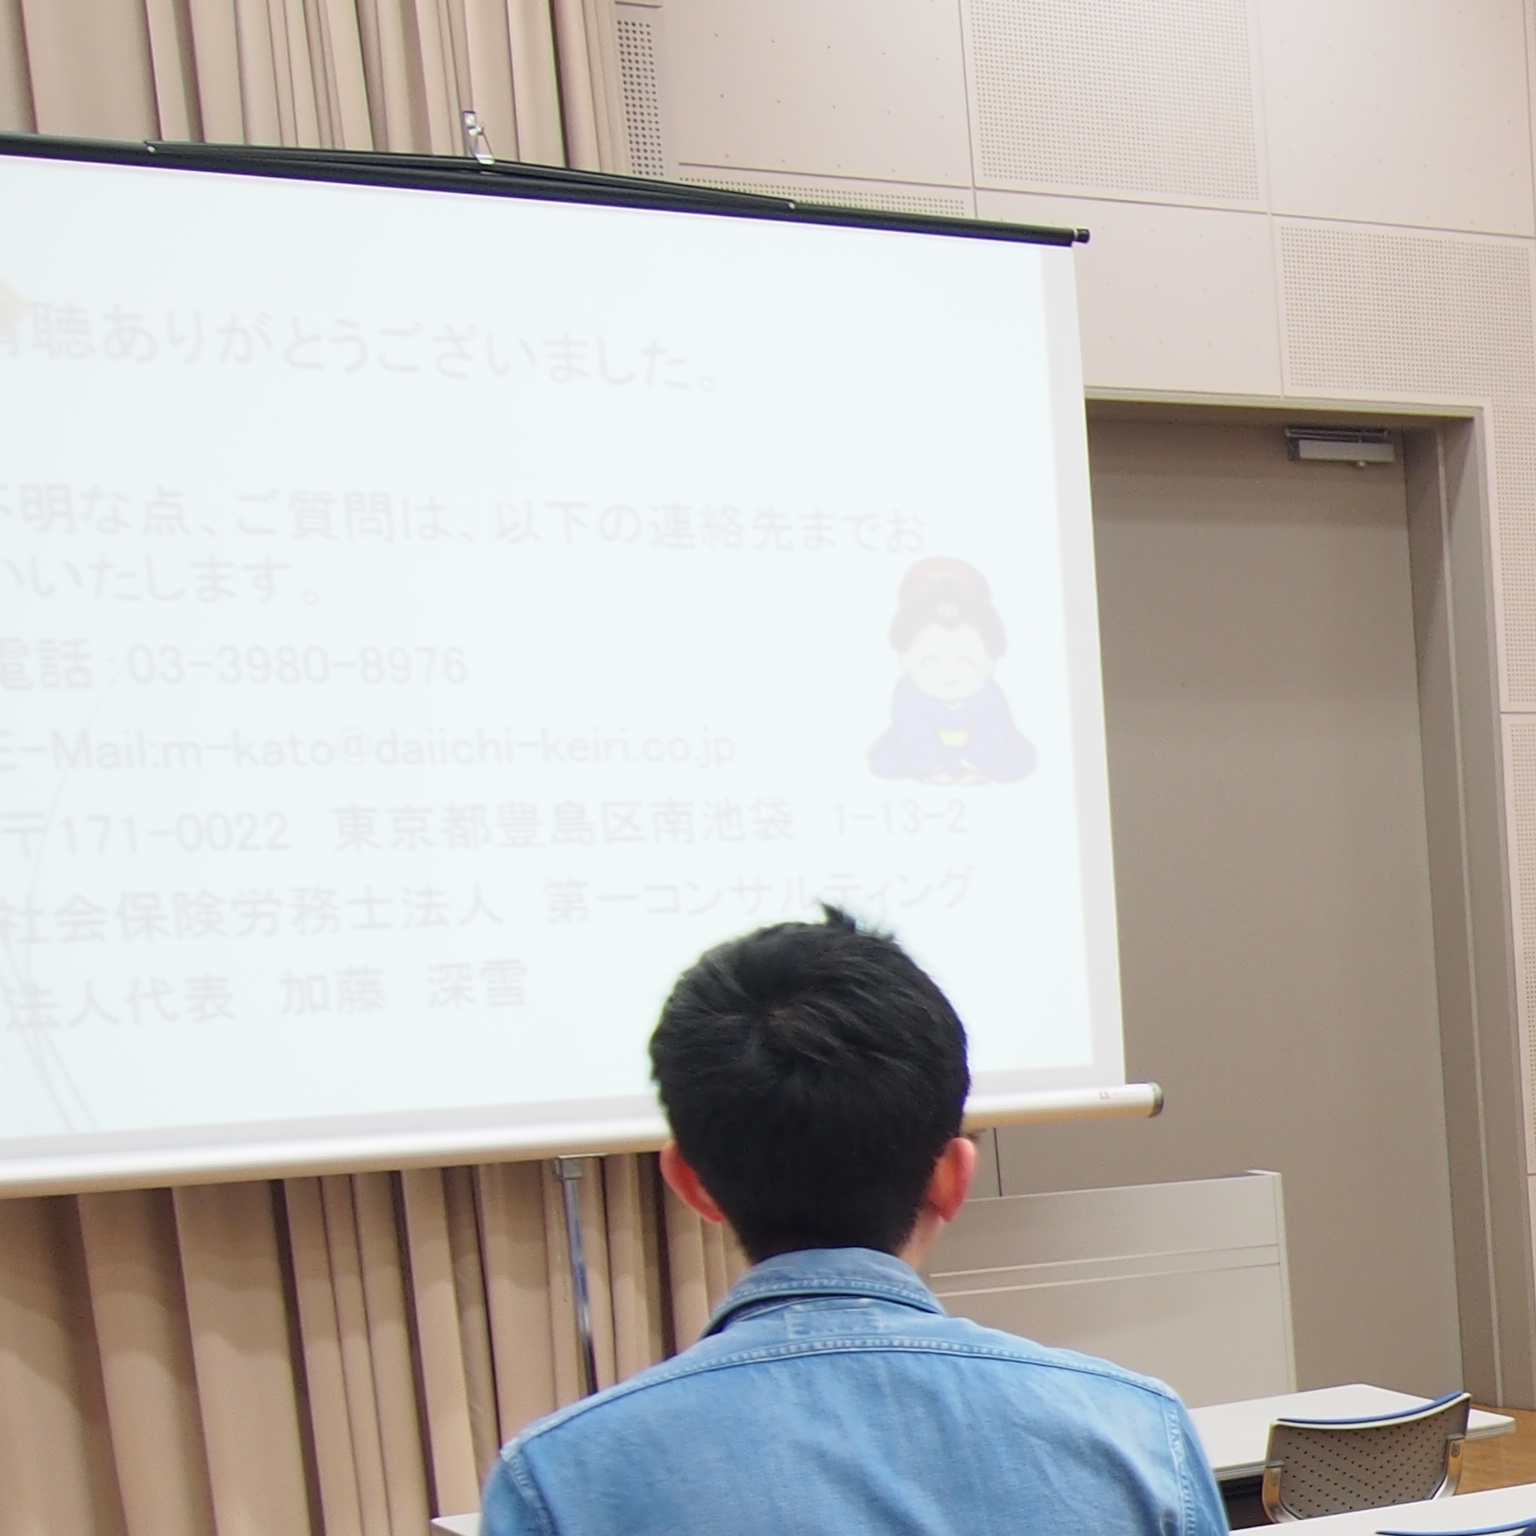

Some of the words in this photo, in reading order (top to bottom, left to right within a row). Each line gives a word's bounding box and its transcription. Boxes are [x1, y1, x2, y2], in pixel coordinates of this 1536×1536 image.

[330, 799, 796, 853] 東京都豊島区南池袋
[831, 798, 970, 837] 1-13-2
[0, 880, 506, 946] 社会保険労務士法人
[543, 864, 976, 926] 第一コンサルティング
[280, 966, 387, 1017] 加藤
[426, 958, 528, 1012] 深雪
